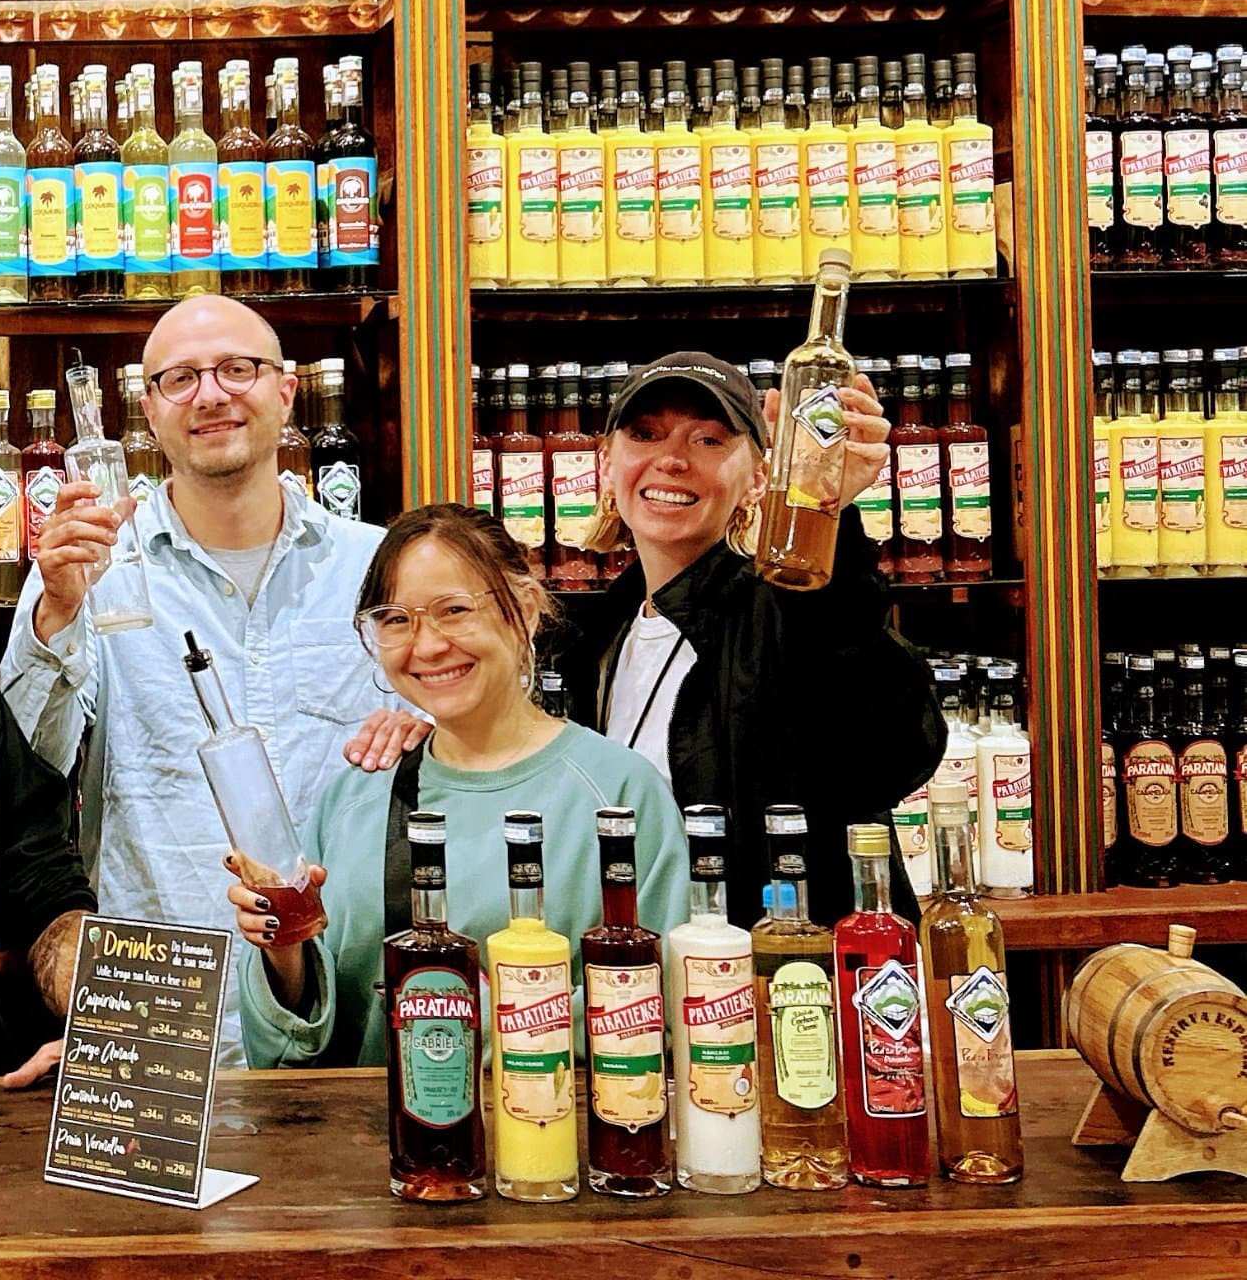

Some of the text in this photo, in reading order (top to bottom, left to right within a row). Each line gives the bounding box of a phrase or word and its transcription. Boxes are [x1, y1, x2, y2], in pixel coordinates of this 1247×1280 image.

[103, 929, 168, 962] Drinks
[76, 985, 132, 1014] Caipirinha
[400, 998, 473, 1018] PARATIANA
[500, 995, 570, 1031] PARATIENSE
[591, 999, 661, 1034] PARATIENSE
[67, 1037, 101, 1062] Jorge
[414, 1037, 464, 1049] GABRIELA
[1162, 1012, 1209, 1067] RESERVA
